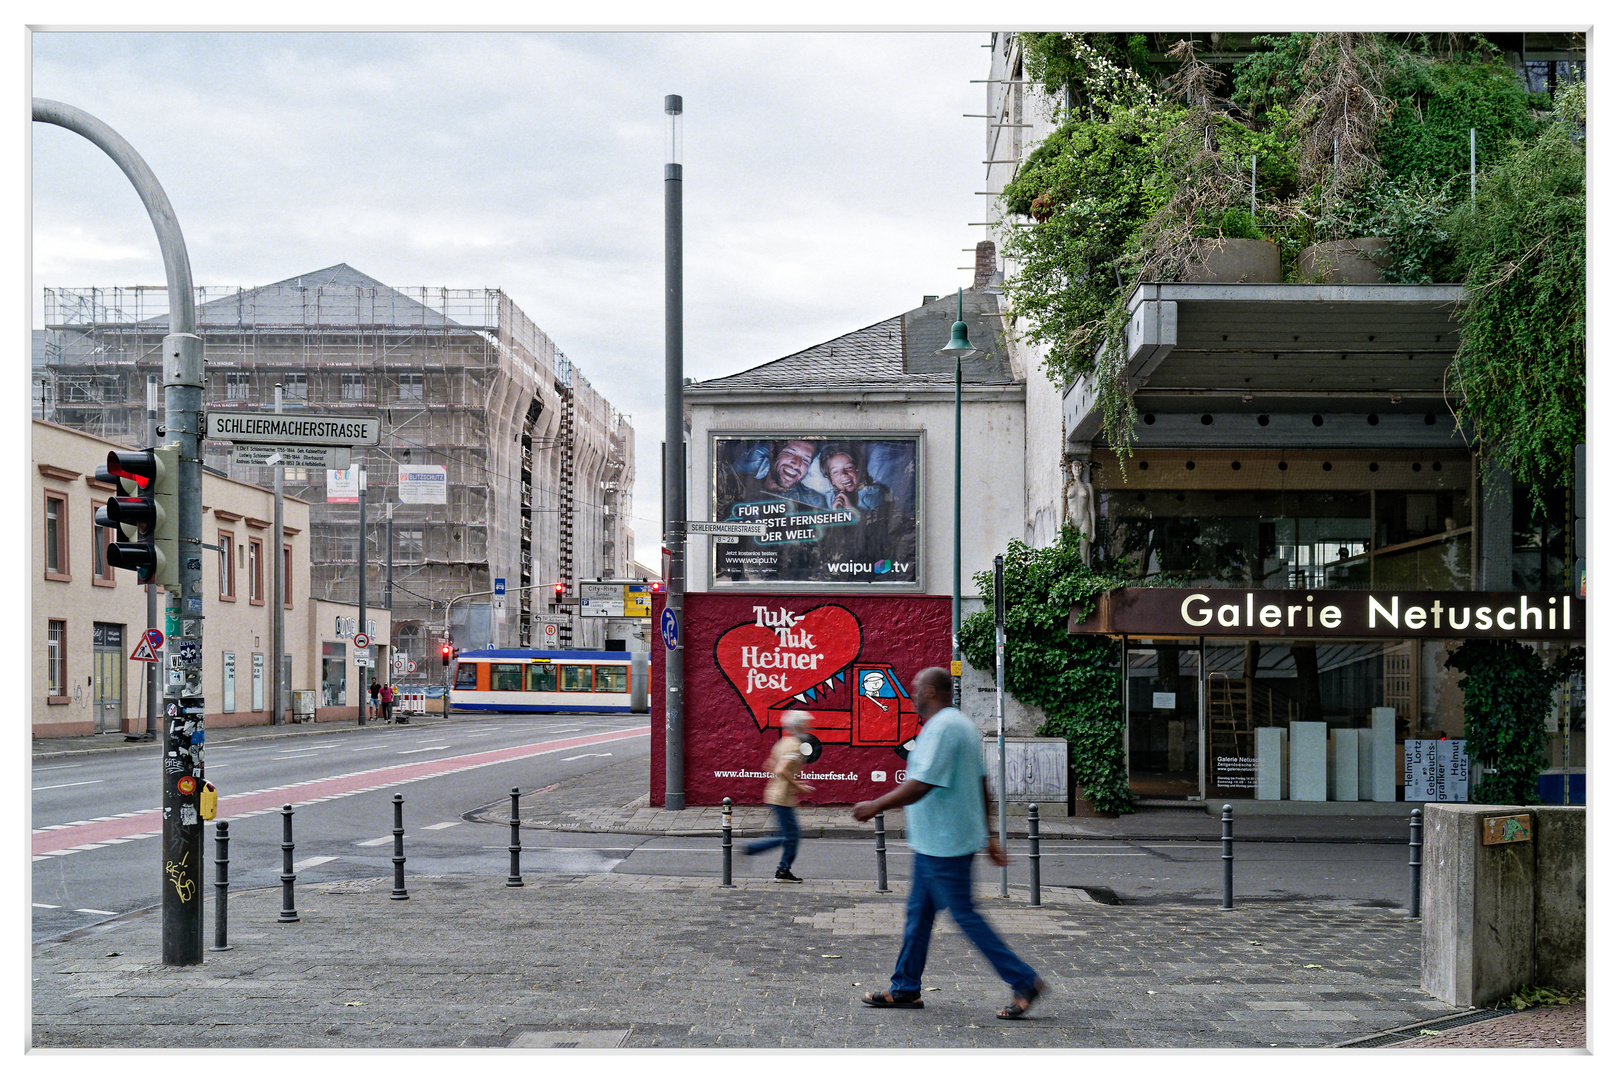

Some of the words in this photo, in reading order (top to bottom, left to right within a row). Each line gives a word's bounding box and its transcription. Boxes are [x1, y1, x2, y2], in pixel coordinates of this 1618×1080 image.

[217, 418, 368, 438] SCHLEIERMACHERSTRASSE
[408, 473, 444, 481] BLITZSCHUTZ
[738, 503, 759, 516] FÜR
[763, 503, 786, 514] UNS
[790, 512, 852, 527] FERNSEHEN
[691, 524, 761, 533] SCHLEIERMACHERSTRASSE
[760, 531, 782, 542] DER
[786, 529, 816, 540] WELT.
[725, 557, 778, 565] www.waipu.tv
[827, 560, 872, 575] waipu
[752, 606, 806, 627] Tuk-
[1180, 592, 1343, 629] Galerie
[1367, 594, 1572, 631] Netuschil
[775, 627, 817, 650] Tuk
[741, 646, 825, 670] Heiner
[746, 668, 792, 694] fest
[1413, 740, 1422, 764] Lortz
[1450, 741, 1459, 776] Helmut
[1404, 752, 1413, 787] Helmut
[1426, 742, 1436, 796] Gebrauchs-
[1458, 758, 1467, 782] Lortz
[1436, 763, 1448, 800] grafiker
